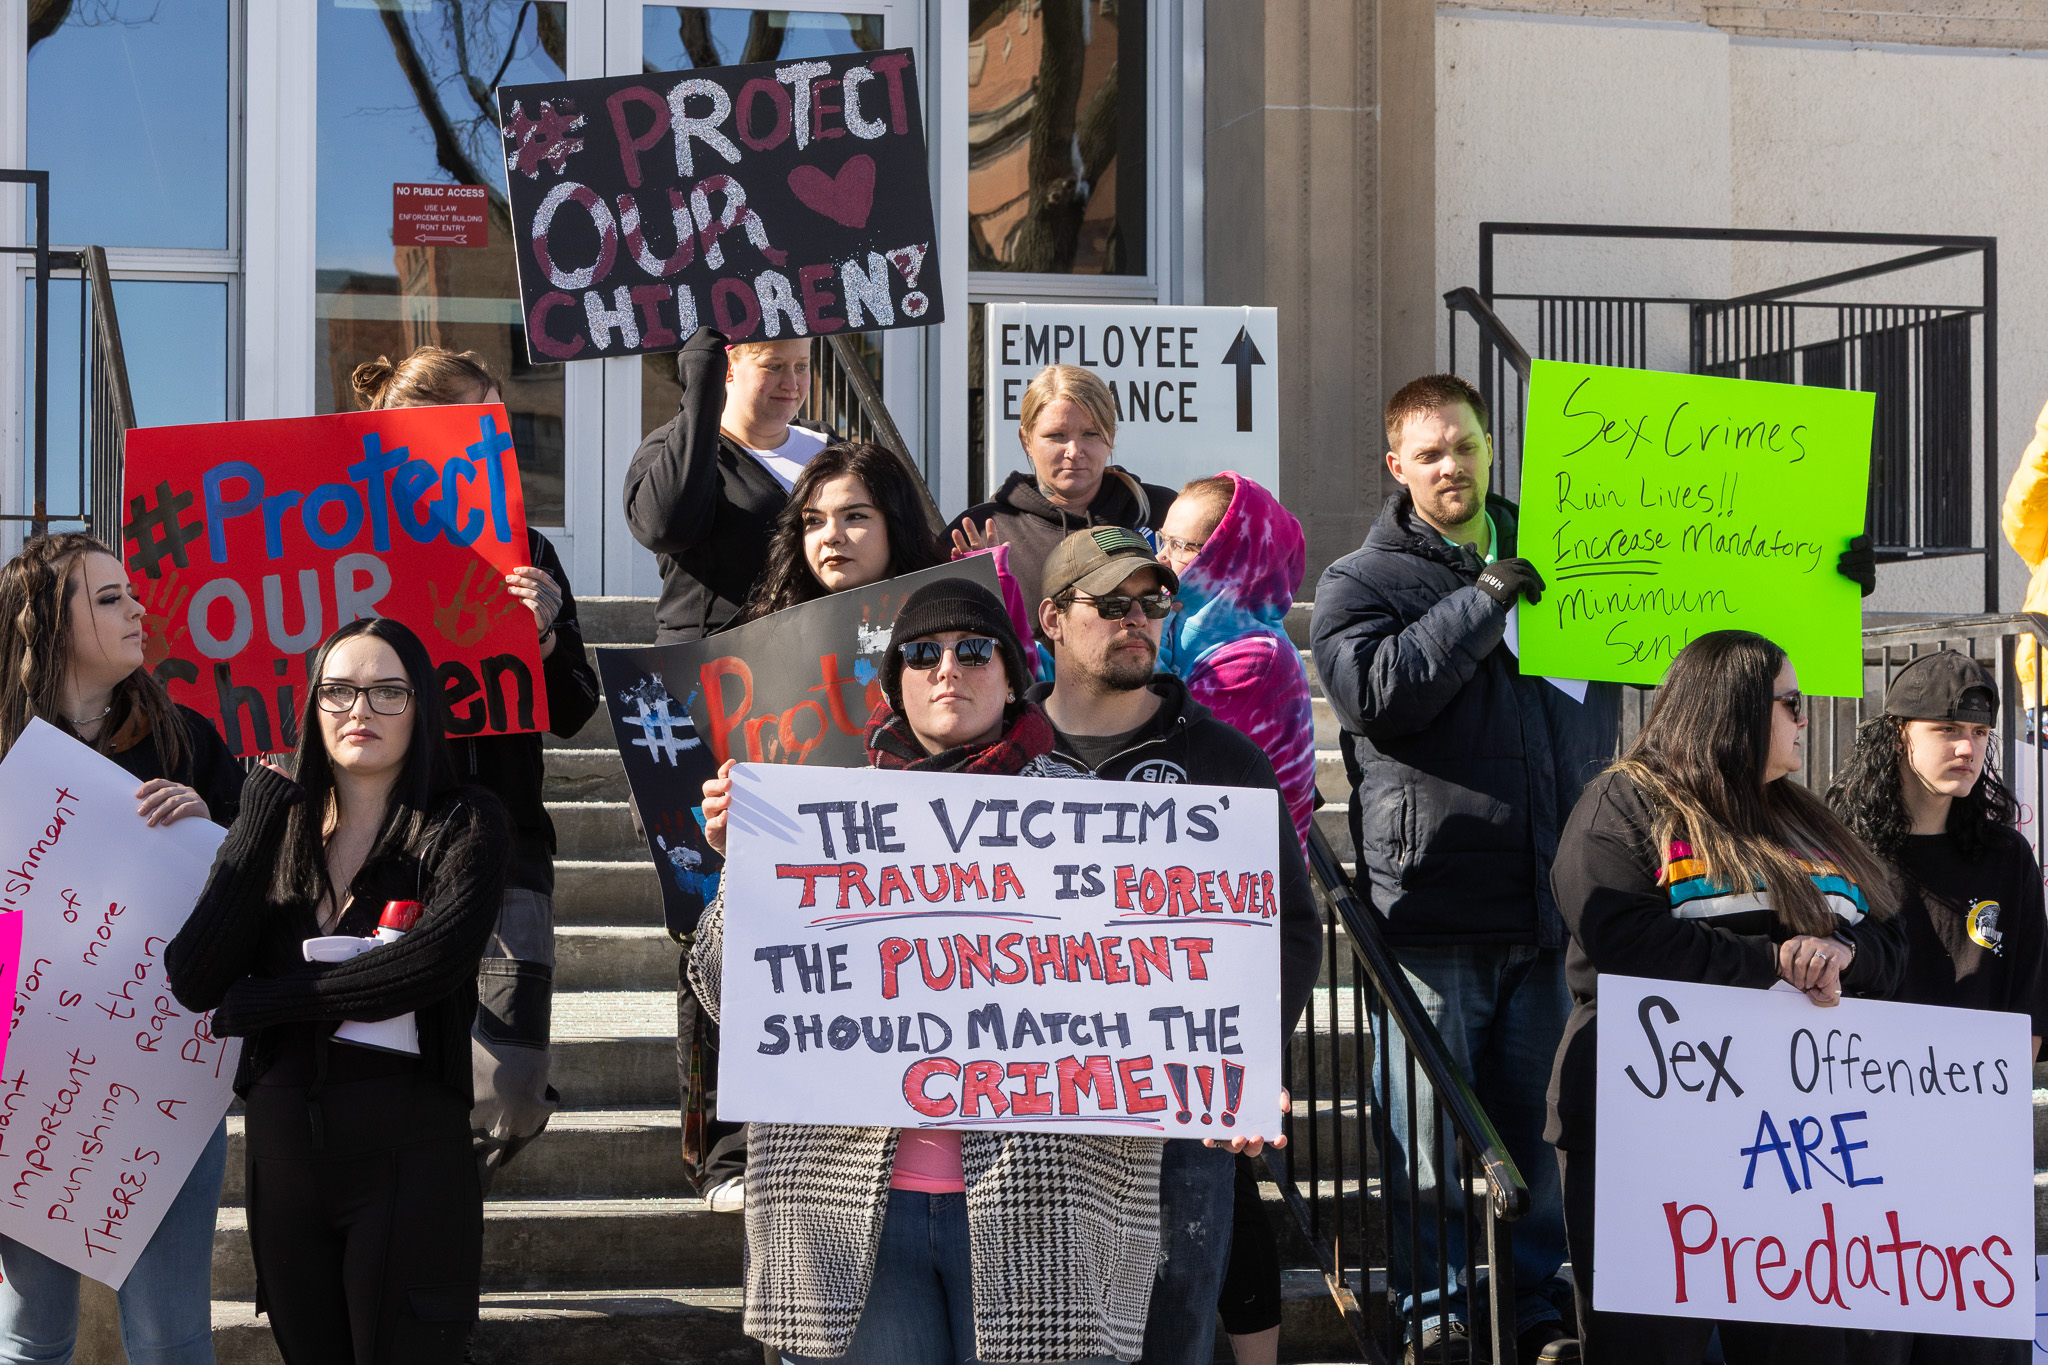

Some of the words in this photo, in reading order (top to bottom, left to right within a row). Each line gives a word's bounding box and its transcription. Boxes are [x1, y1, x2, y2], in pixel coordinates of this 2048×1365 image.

[396, 187, 410, 195] NO
[413, 187, 444, 196] PUBLIC
[447, 188, 485, 198] ACCESS
[398, 213, 450, 222] ENFORCEMENT
[452, 214, 483, 223] BUILDING
[416, 223, 440, 231] FRONT
[441, 224, 466, 232] ENTRY
[424, 204, 438, 212] USE
[531, 173, 787, 290] OUR
[1001, 324, 1199, 369] EMPLOYEE
[1003, 379, 1198, 423] EANCE
[1562, 377, 1652, 459] Sex
[1664, 402, 1809, 463] Crimes
[123, 414, 515, 580] #Protect
[1555, 471, 1627, 513] Ruin
[1639, 472, 1738, 518] Lives!!
[1552, 520, 1671, 564] Increase
[1682, 522, 1823, 574] Mandatory
[187, 552, 392, 660] OUR
[0, 787, 80, 914] ishment
[798, 798, 906, 860] THE
[929, 795, 1231, 853] VICTIMS'
[60, 888, 82, 923] of
[776, 861, 1026, 909] TRAUMA
[1054, 864, 1107, 900] IS
[1114, 864, 1278, 919] FOREVER
[47, 989, 82, 1022] is
[82, 902, 127, 966] more
[95, 936, 168, 1020] than
[753, 943, 853, 994] THE
[878, 931, 1214, 1000] PUNSHMENT
[757, 1012, 952, 1056] SHOULD
[967, 1003, 1133, 1051] MATCH
[1148, 1005, 1245, 1055] THE
[1624, 995, 1745, 1103] Sex
[1790, 1028, 2009, 1097] Offenders
[902, 1054, 1247, 1128] CRIME!!!
[47, 1082, 140, 1223] punishing
[84, 1146, 160, 1258] THERE'S
[156, 1099, 187, 1121] A
[1740, 1109, 1884, 1195] ARE
[1662, 1201, 2016, 1312] Predators
